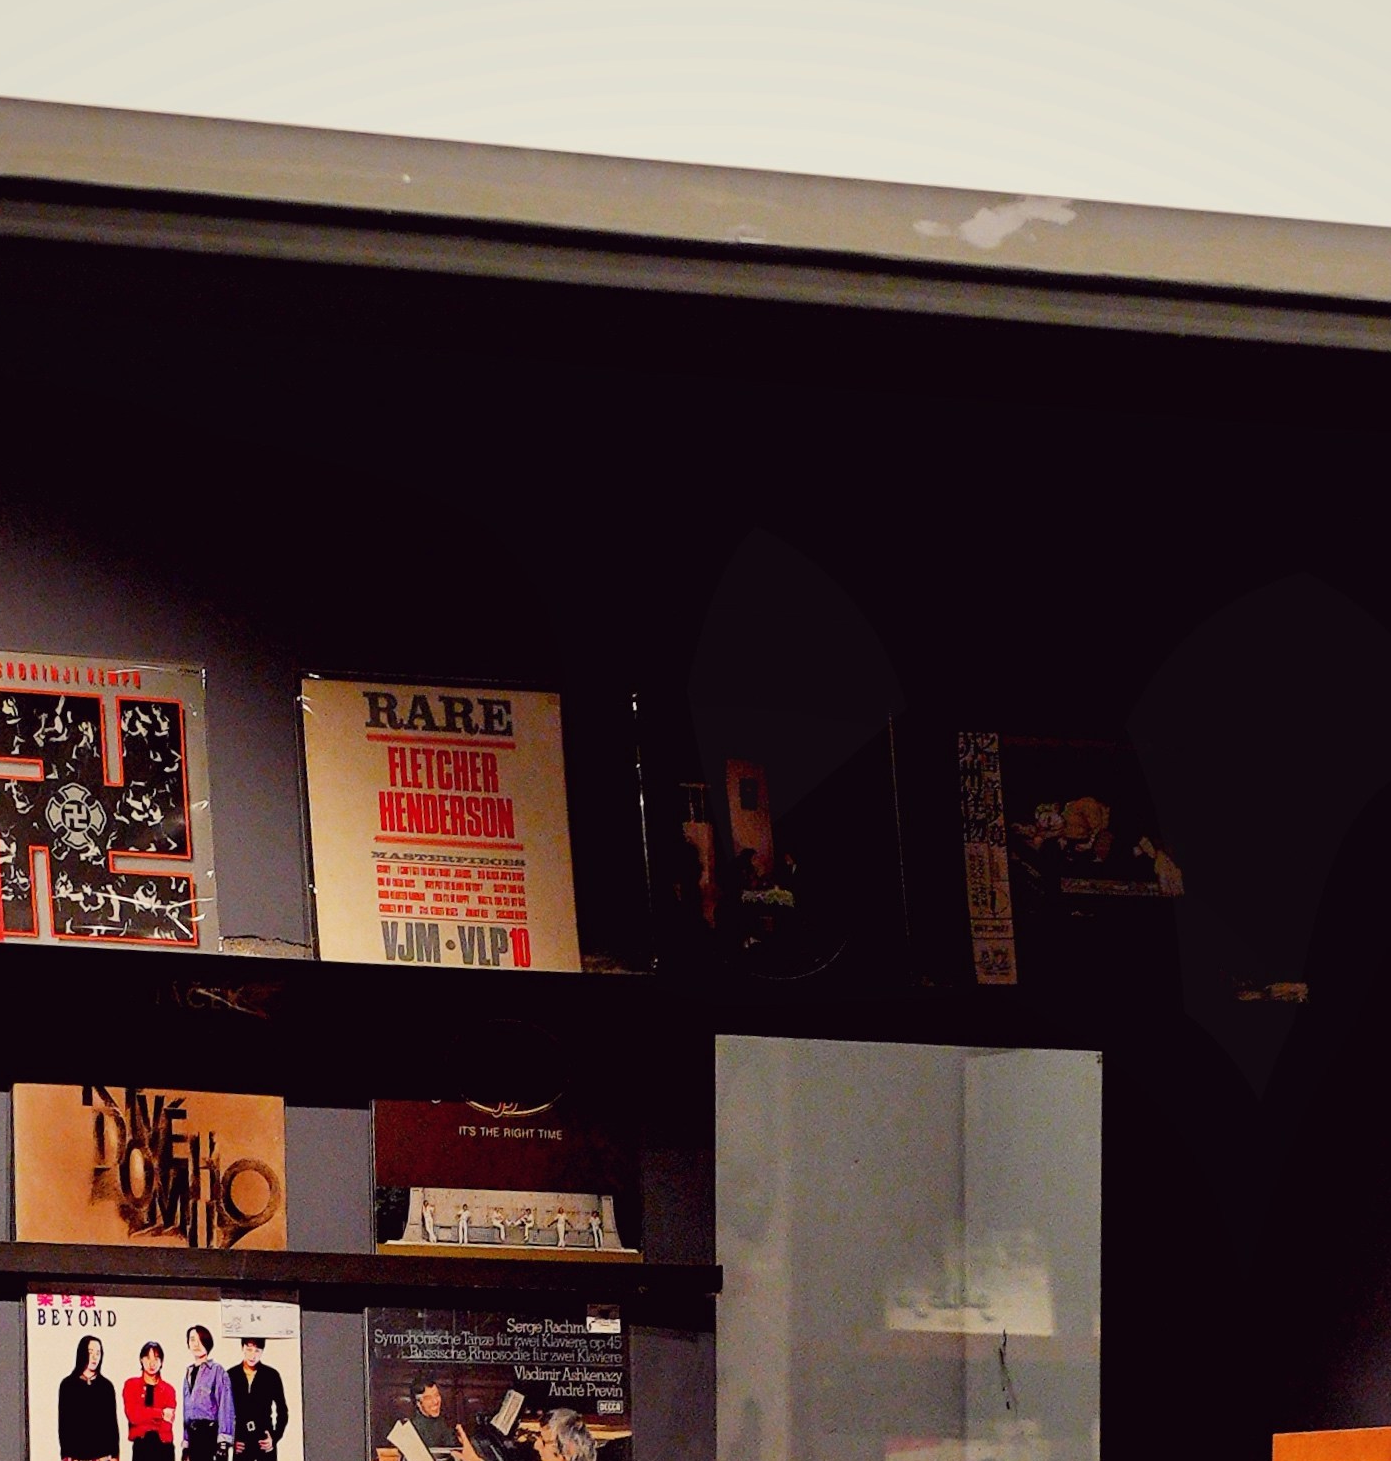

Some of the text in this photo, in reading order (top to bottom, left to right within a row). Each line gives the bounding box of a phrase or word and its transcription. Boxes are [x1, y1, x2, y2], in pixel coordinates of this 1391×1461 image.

[363, 691, 513, 738] RARE
[388, 746, 499, 793] FLETCHER
[378, 791, 515, 839] HENDERSON
[371, 850, 526, 867] MASTERPIECES
[381, 920, 441, 964] VJM
[479, 1126, 500, 1139] THE
[503, 1127, 535, 1140] RIGHT
[538, 1129, 563, 1141] TIME
[37, 1308, 117, 1327] BEYOND
[507, 1318, 542, 1335] Serge
[374, 1329, 460, 1346] Symphonische
[461, 1330, 494, 1346] Tänze
[496, 1332, 514, 1346] für
[514, 1335, 540, 1347] zwei
[409, 1347, 622, 1364] Russische Rhapsodie für zwei Klaviere
[514, 1365, 623, 1384] Vladimir Ashkenazy
[548, 1381, 623, 1398] André Previn
